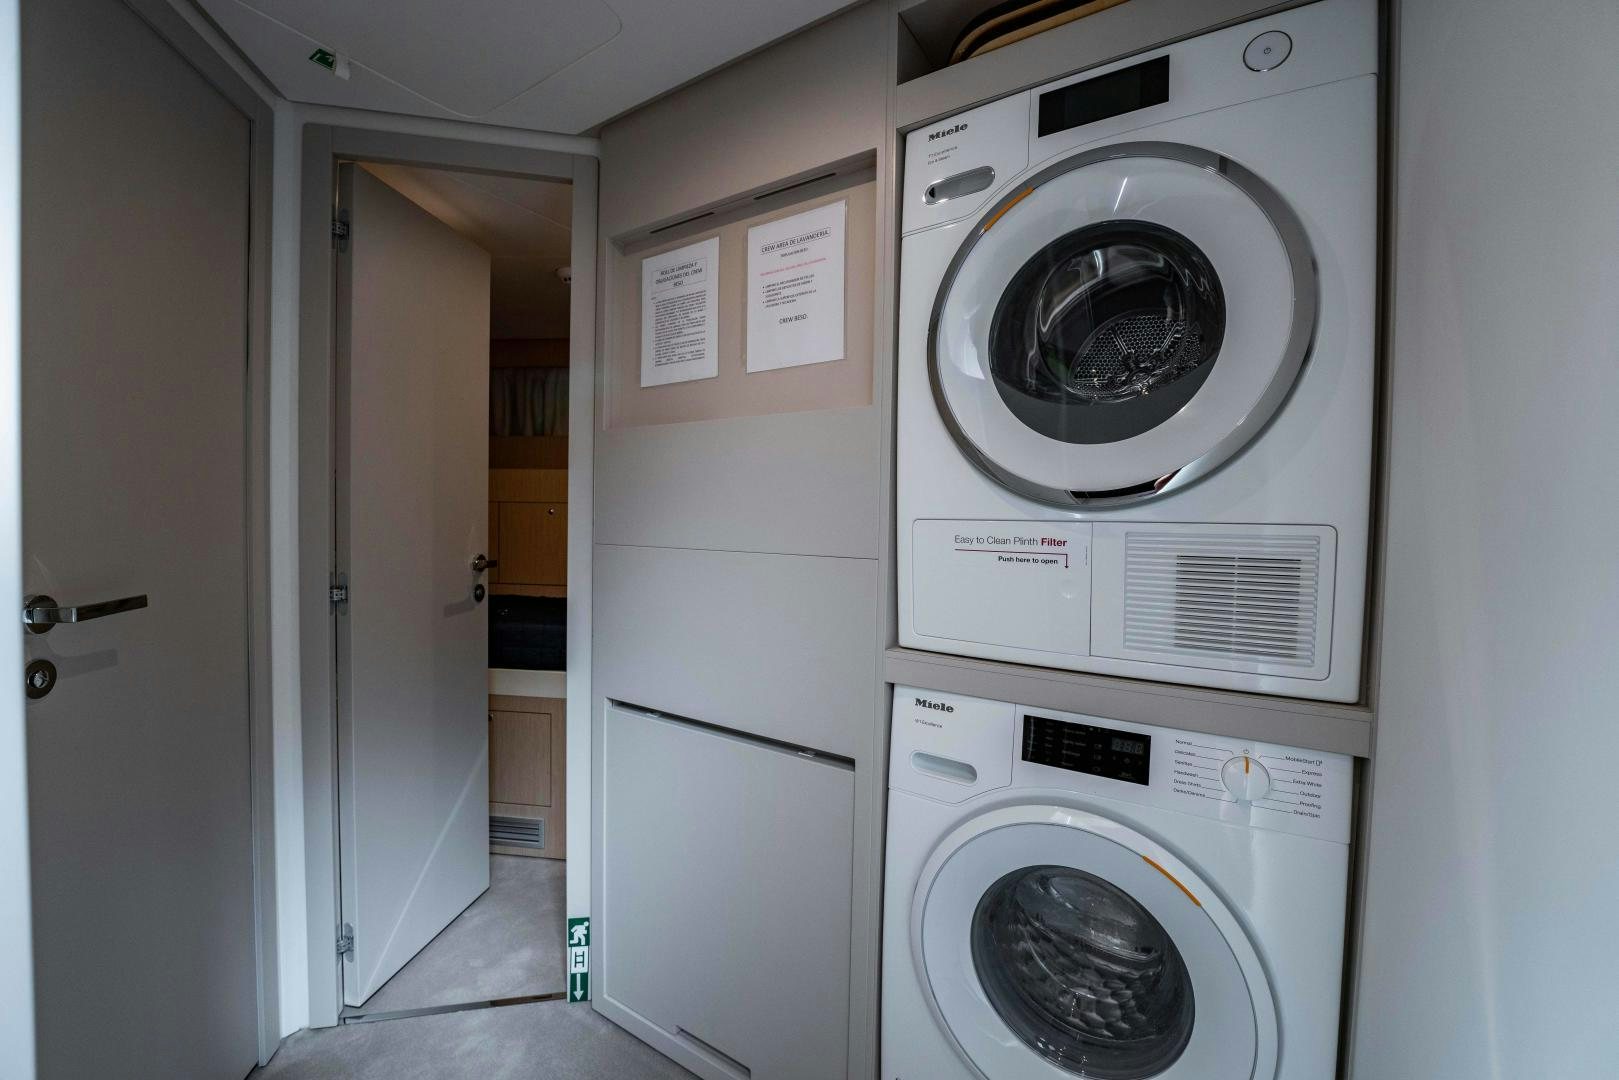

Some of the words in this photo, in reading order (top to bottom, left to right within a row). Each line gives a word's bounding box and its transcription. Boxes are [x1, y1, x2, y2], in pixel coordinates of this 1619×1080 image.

[928, 124, 968, 142] Miele
[761, 245, 775, 253] CREW
[789, 238, 796, 246] DE
[779, 316, 793, 325] CREW
[954, 535, 974, 545] Easy
[976, 536, 985, 544] to
[986, 535, 1011, 545] Clean
[1013, 536, 1039, 546] Plinth
[1041, 537, 1067, 547] Filter
[998, 555, 1014, 563] Push
[1015, 556, 1031, 564] here
[1040, 558, 1058, 566] open
[915, 697, 954, 713] Miele
[1301, 769, 1322, 777] Express
[1299, 801, 1322, 810] Proofing
